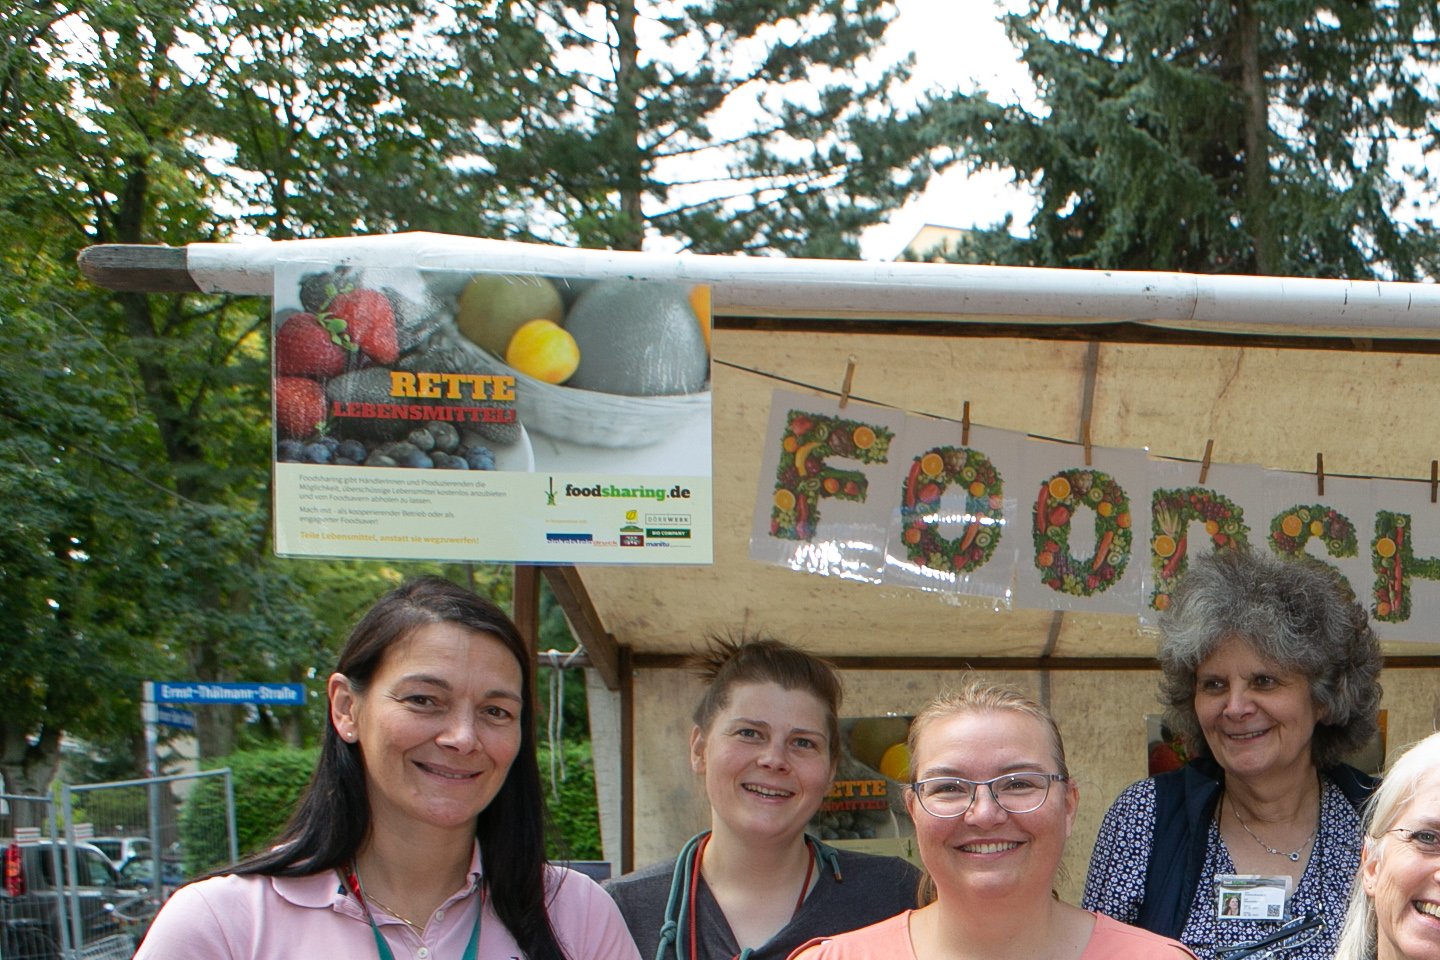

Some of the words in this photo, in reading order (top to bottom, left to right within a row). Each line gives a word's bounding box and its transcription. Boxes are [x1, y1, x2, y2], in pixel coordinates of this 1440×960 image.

[389, 371, 516, 401] RETTE
[332, 401, 517, 424] LEBENSMITTEL!
[565, 483, 691, 502] foodsharing.de
